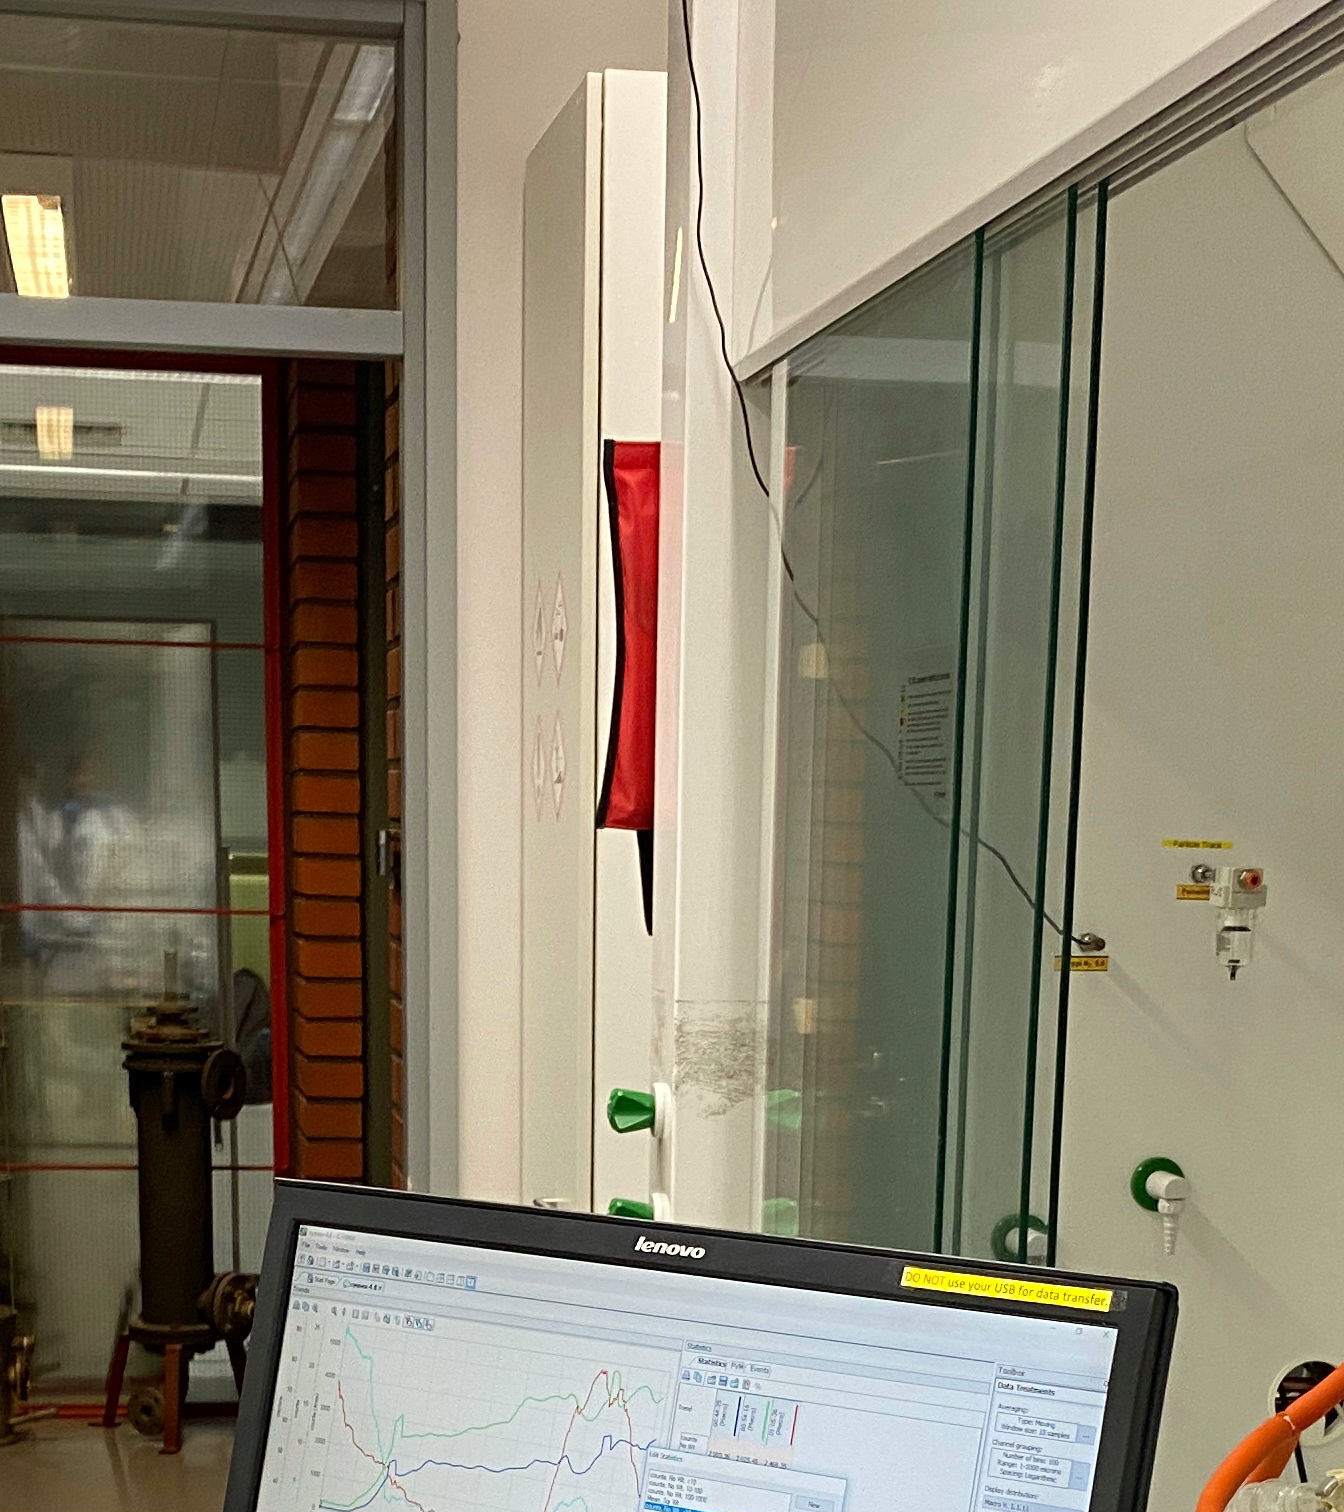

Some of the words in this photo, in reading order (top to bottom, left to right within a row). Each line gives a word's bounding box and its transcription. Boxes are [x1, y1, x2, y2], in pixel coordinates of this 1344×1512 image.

[634, 1236, 706, 1259] lenovo
[906, 1271, 921, 1283] DO
[923, 1274, 945, 1286] NOT
[948, 1279, 965, 1288] use
[968, 1281, 991, 1293] your
[994, 1283, 1015, 1294] USB
[1018, 1285, 1032, 1297] for
[1036, 1288, 1060, 1300] data
[1062, 1291, 1108, 1307] transfer.
[698, 1357, 727, 1368] Statistics
[998, 1367, 1025, 1377] Toolbox
[998, 1382, 1014, 1391] Data
[1016, 1384, 1055, 1396] Treatments
[1001, 1423, 1023, 1432] Window
[992, 1440, 1015, 1448] Channel
[1003, 1452, 1024, 1461] Number
[984, 1485, 1005, 1496] Display
